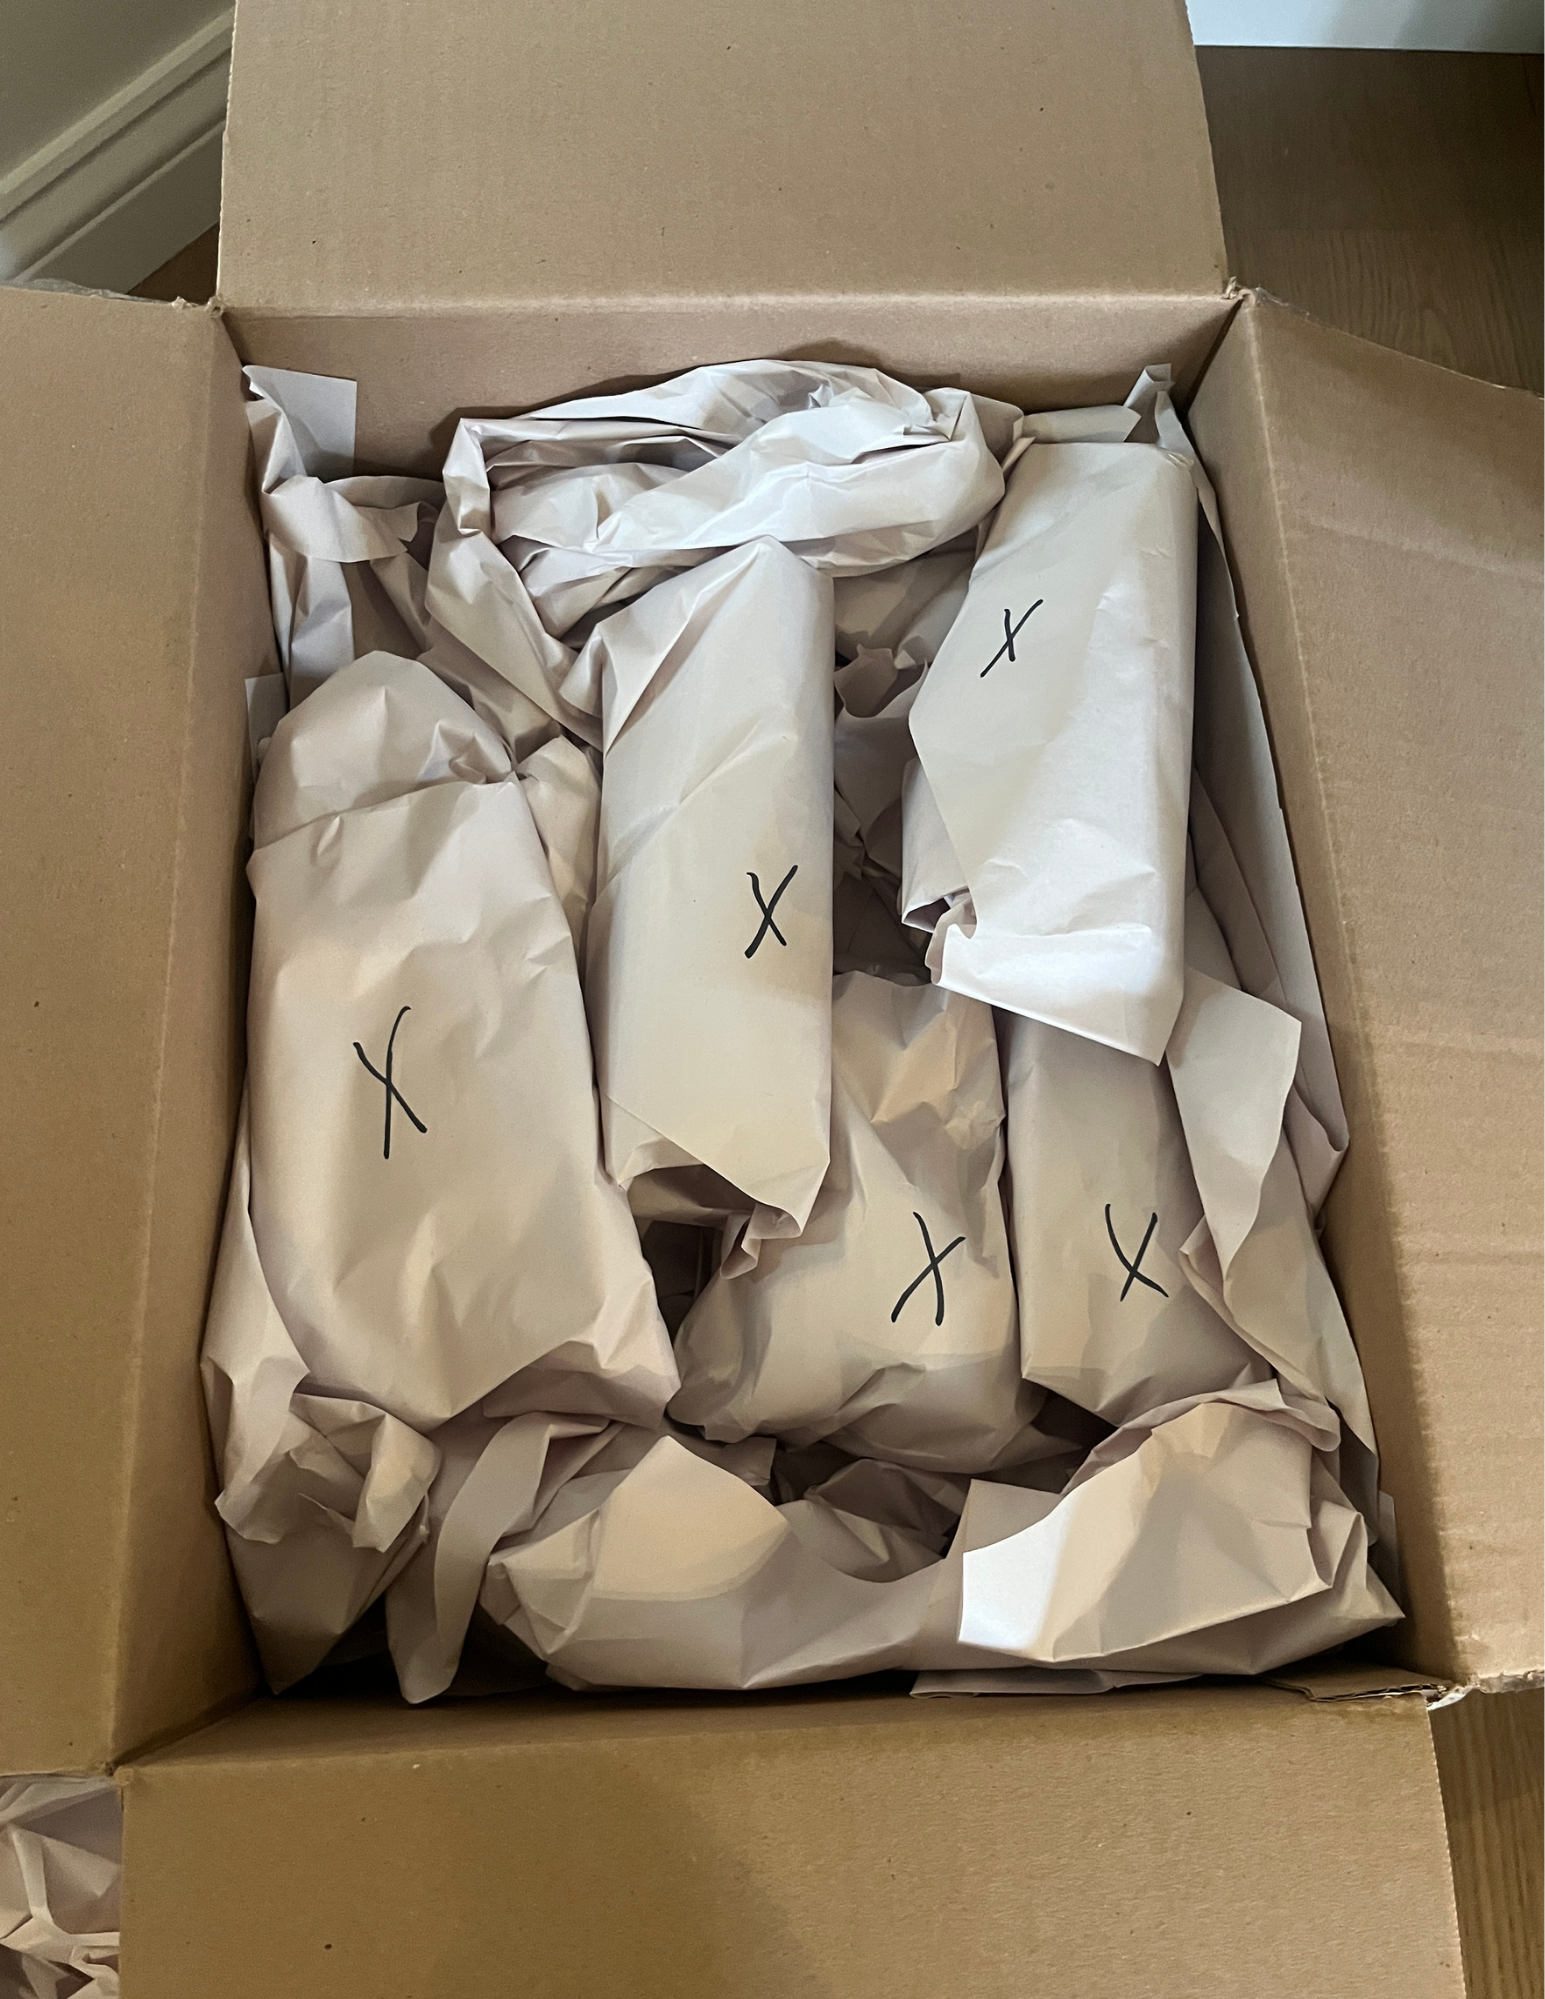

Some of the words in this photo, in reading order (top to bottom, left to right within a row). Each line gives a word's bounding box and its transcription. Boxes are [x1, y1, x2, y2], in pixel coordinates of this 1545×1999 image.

[980, 599, 1043, 678] X
[744, 864, 799, 959] X
[352, 1005, 428, 1160] X
[890, 1211, 966, 1327] X
[1104, 1203, 1170, 1302] X
